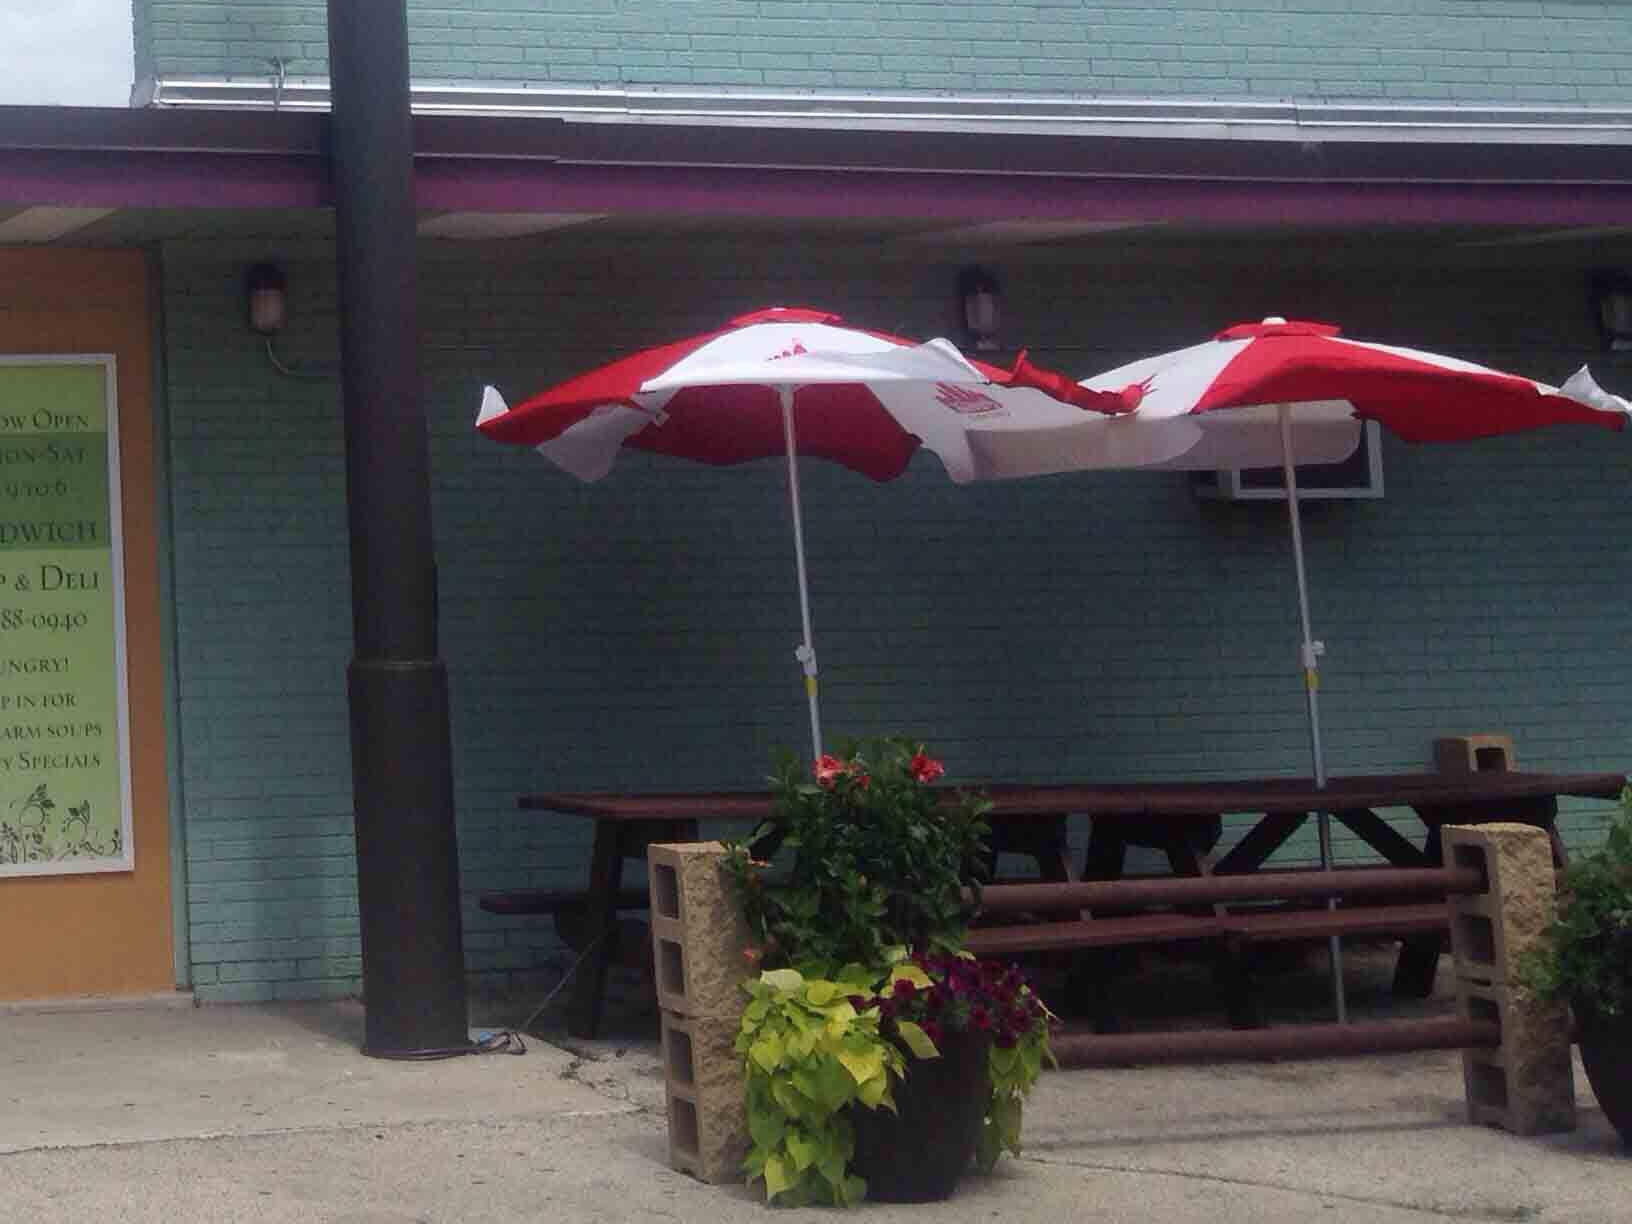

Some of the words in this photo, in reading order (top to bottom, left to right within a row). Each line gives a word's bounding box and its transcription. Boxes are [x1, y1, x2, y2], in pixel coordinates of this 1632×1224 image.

[32, 407, 89, 431] OPEN
[14, 572, 31, 593] &
[40, 563, 100, 592] DELI
[16, 695, 39, 710] IN
[42, 693, 78, 710] FOR
